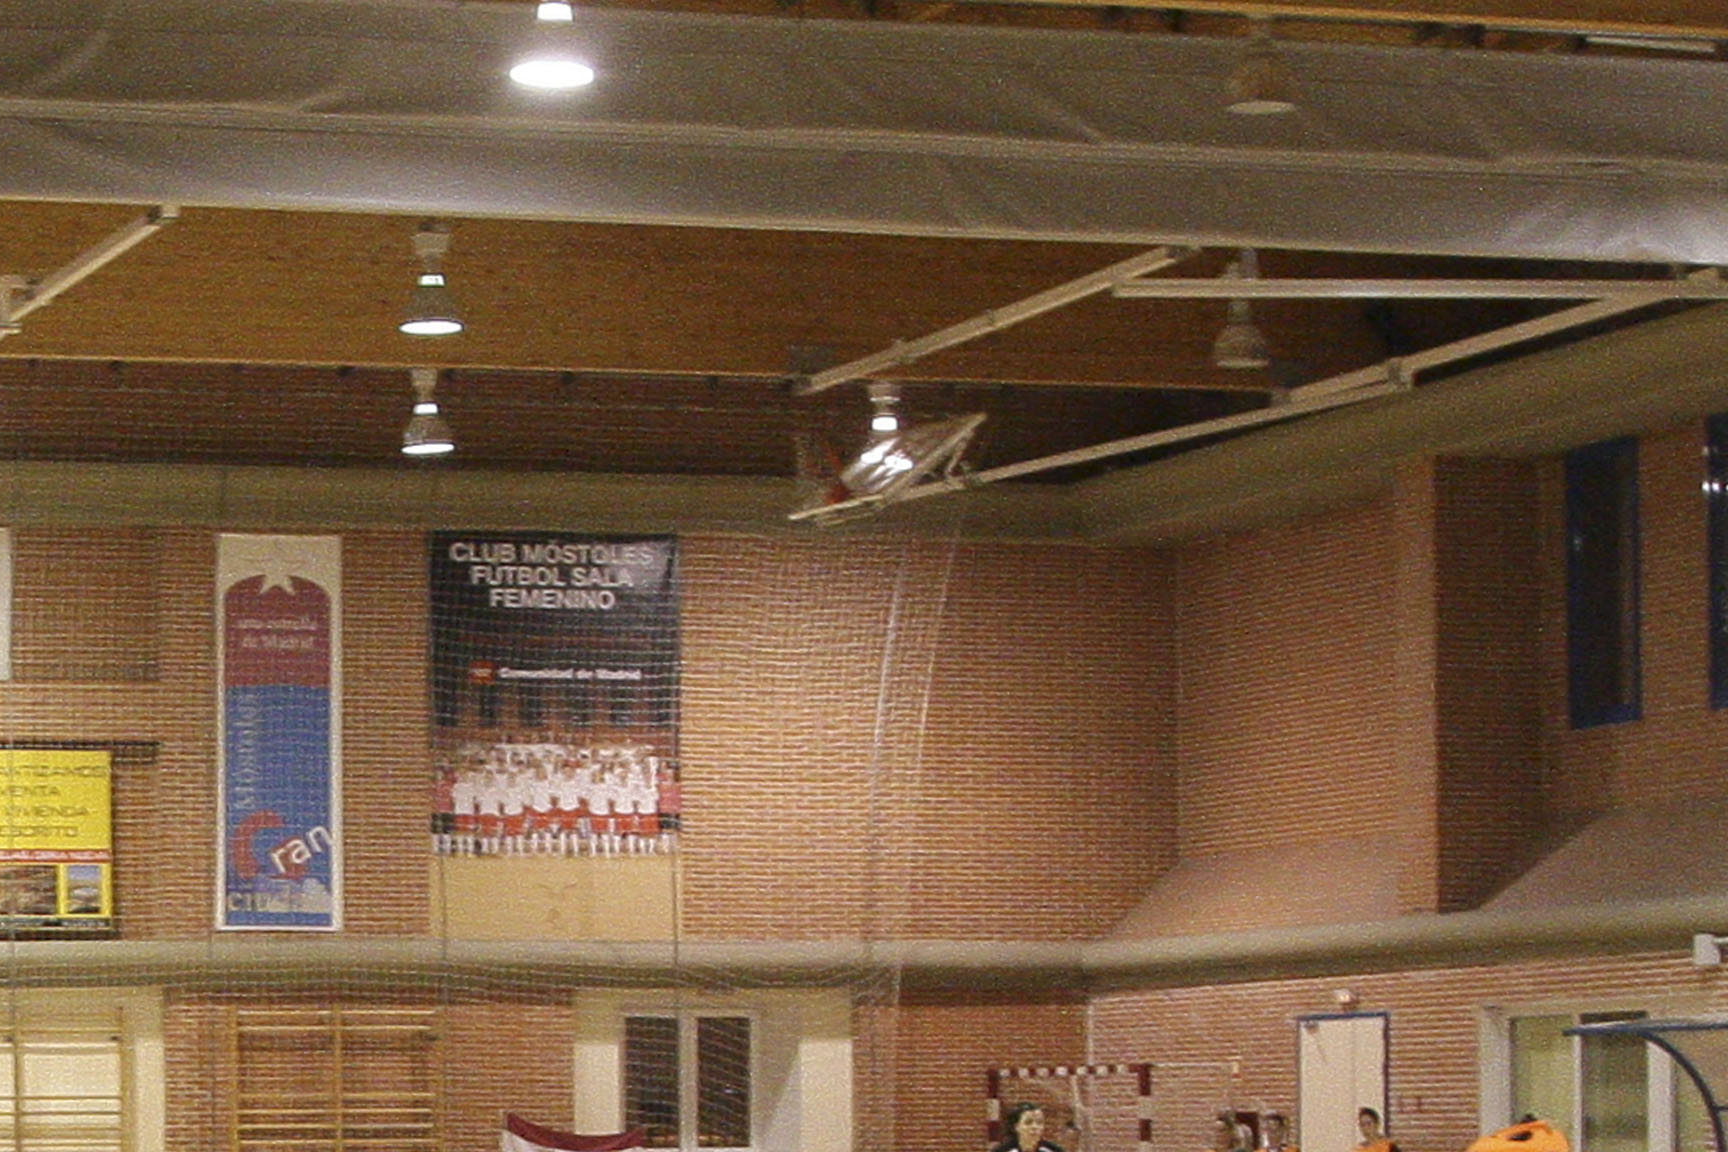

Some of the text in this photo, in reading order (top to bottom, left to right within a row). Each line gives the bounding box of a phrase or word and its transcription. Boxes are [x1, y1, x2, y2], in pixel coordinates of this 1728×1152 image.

[449, 542, 516, 563] CLUB
[572, 566, 634, 588] SALA
[489, 588, 616, 609] FEMENINO
